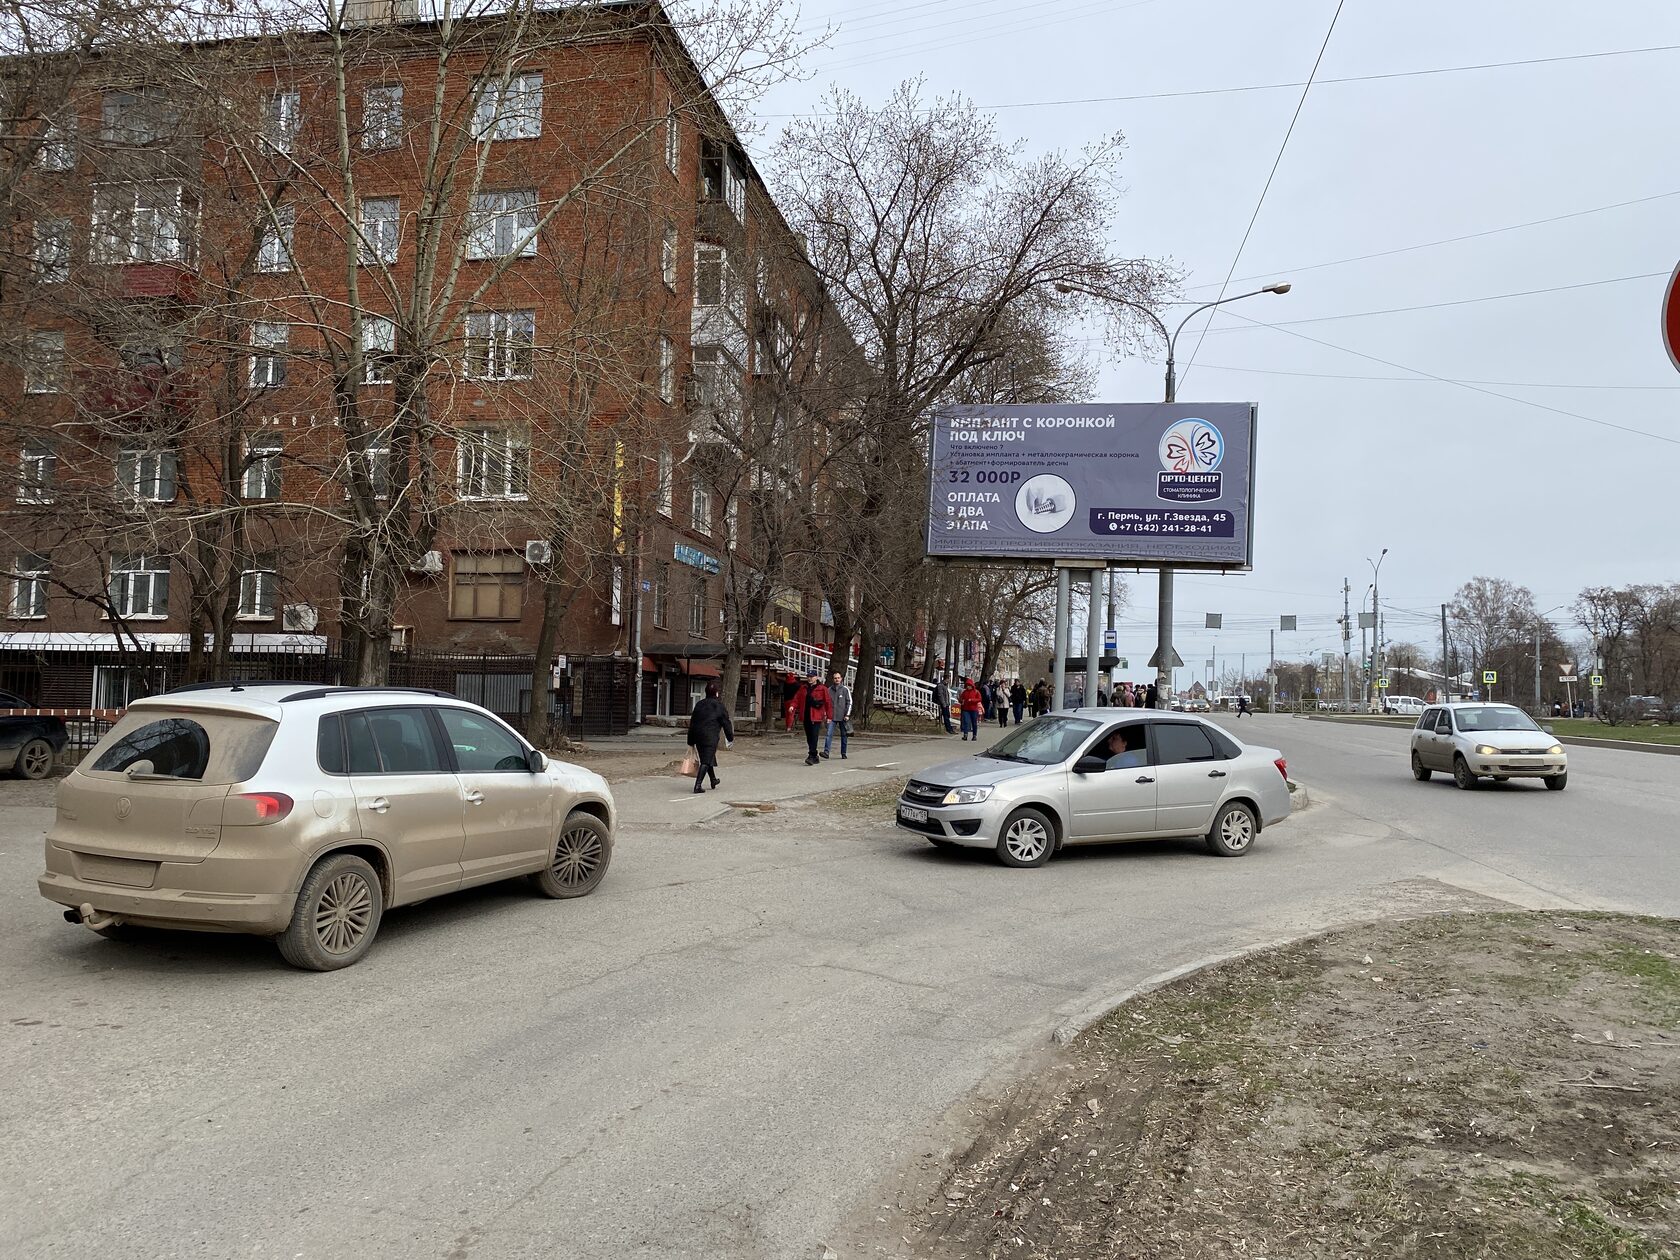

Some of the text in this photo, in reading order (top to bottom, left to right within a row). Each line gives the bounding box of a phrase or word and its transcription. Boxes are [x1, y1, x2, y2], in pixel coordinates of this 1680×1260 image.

[1023, 417, 1032, 428] С
[1036, 414, 1115, 428] КОРОНКОЙ
[949, 431, 1025, 443] ПОД КЛЮЧ
[949, 470, 969, 483] 32
[1161, 475, 1219, 483] ОРТО-ЦЕНТР
[947, 492, 1000, 503] ОПЛАТА
[958, 506, 984, 518] ДВА
[1108, 512, 1143, 521] Пермь,
[1146, 514, 1161, 522] ул.
[1164, 513, 1210, 522] Г.Звезда,
[1213, 514, 1226, 522] 45
[1134, 523, 1159, 532] (342)
